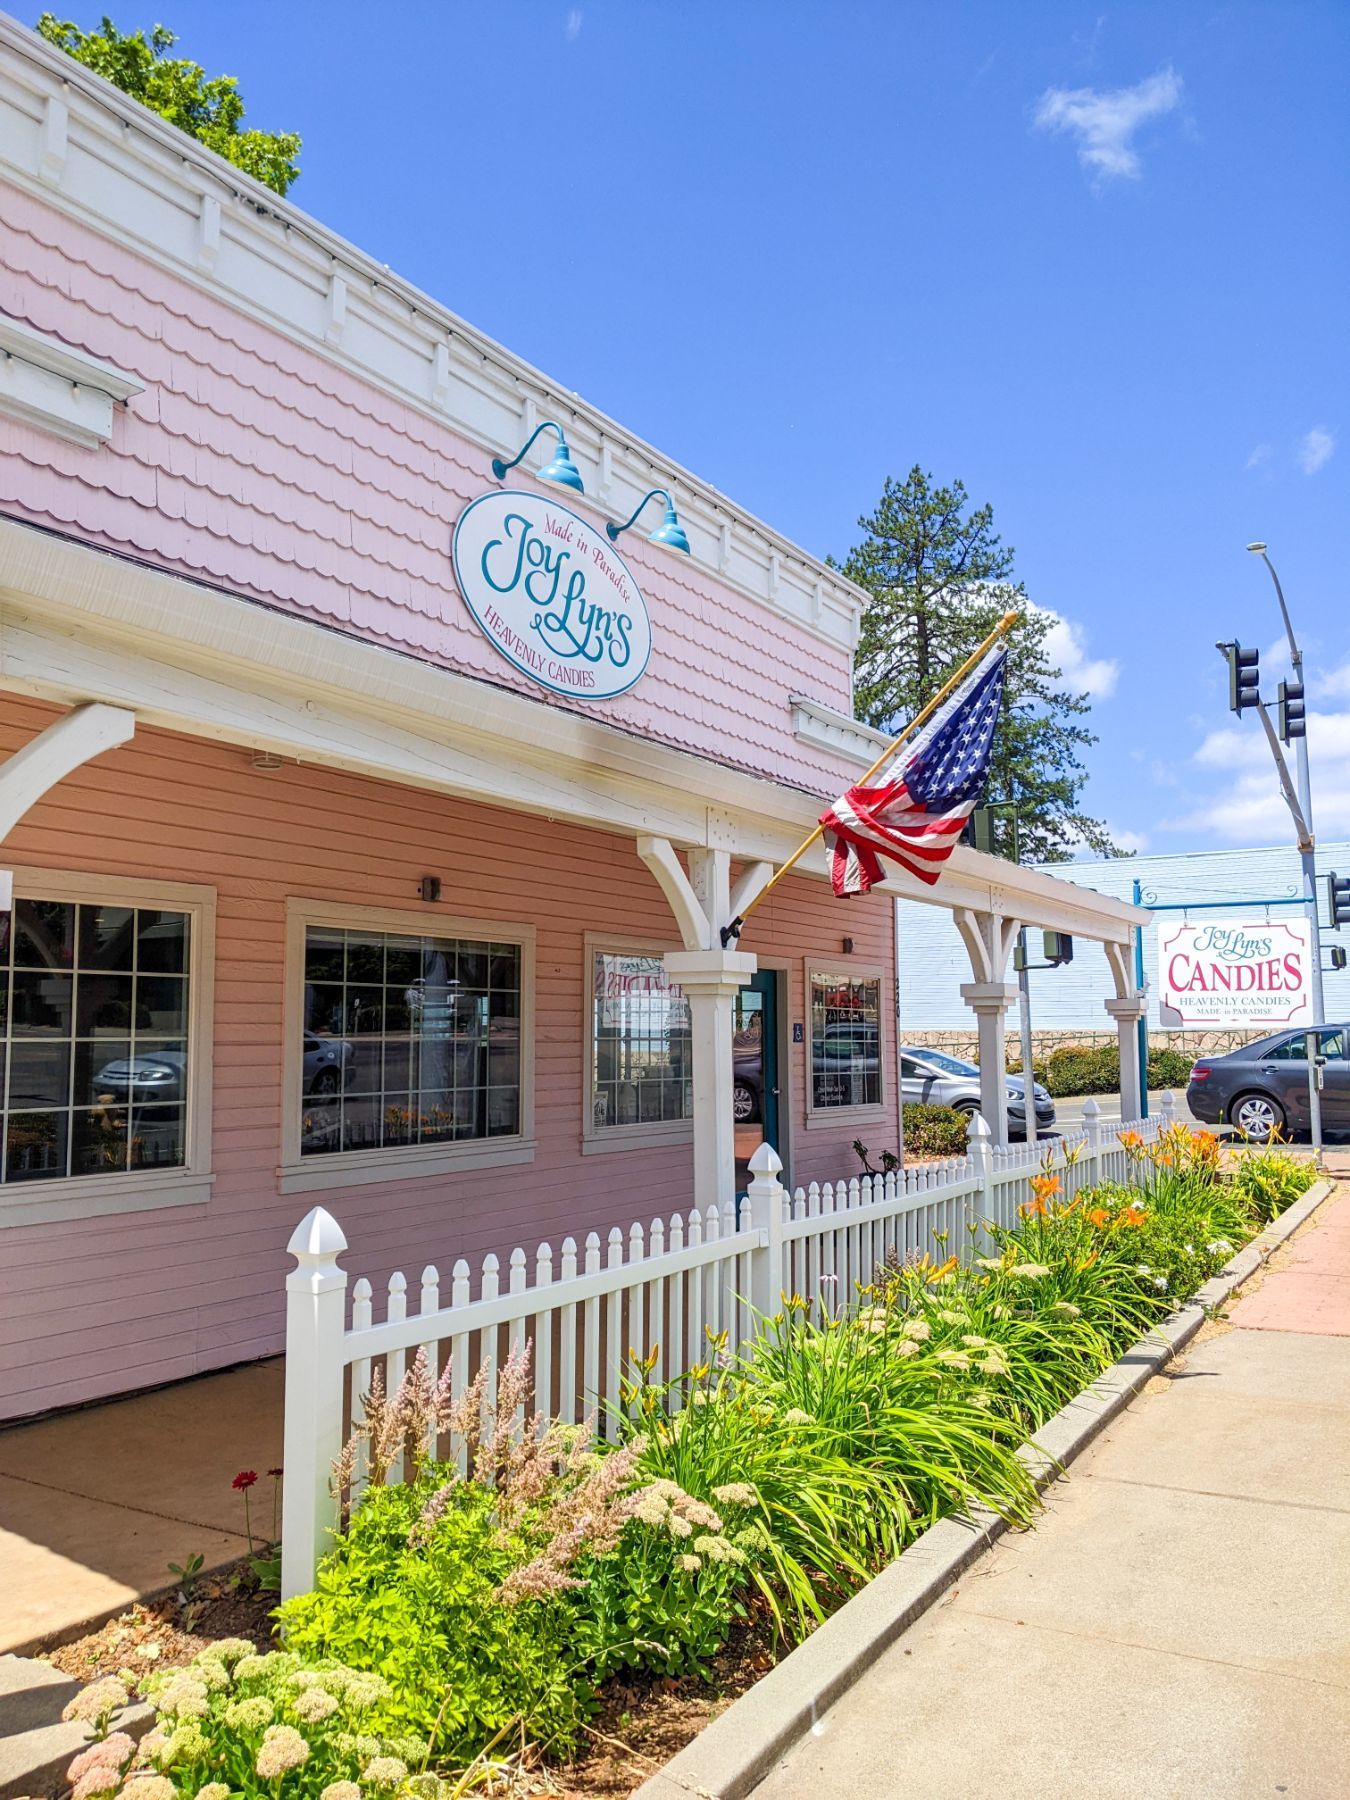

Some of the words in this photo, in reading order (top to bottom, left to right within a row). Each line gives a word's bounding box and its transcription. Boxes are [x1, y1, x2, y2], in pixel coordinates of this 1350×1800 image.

[481, 513, 570, 606] Joy
[544, 513, 574, 543] Made
[576, 533, 588, 554] in
[592, 547, 631, 604] Paradise
[483, 605, 547, 673] HEAVENLY
[548, 662, 596, 688] CANDIES
[1193, 926, 1235, 951] Joy
[1168, 952, 1303, 992] CANDIES
[1179, 997, 1238, 1006] HEAVENLY
[1241, 996, 1291, 1006] CANDIES
